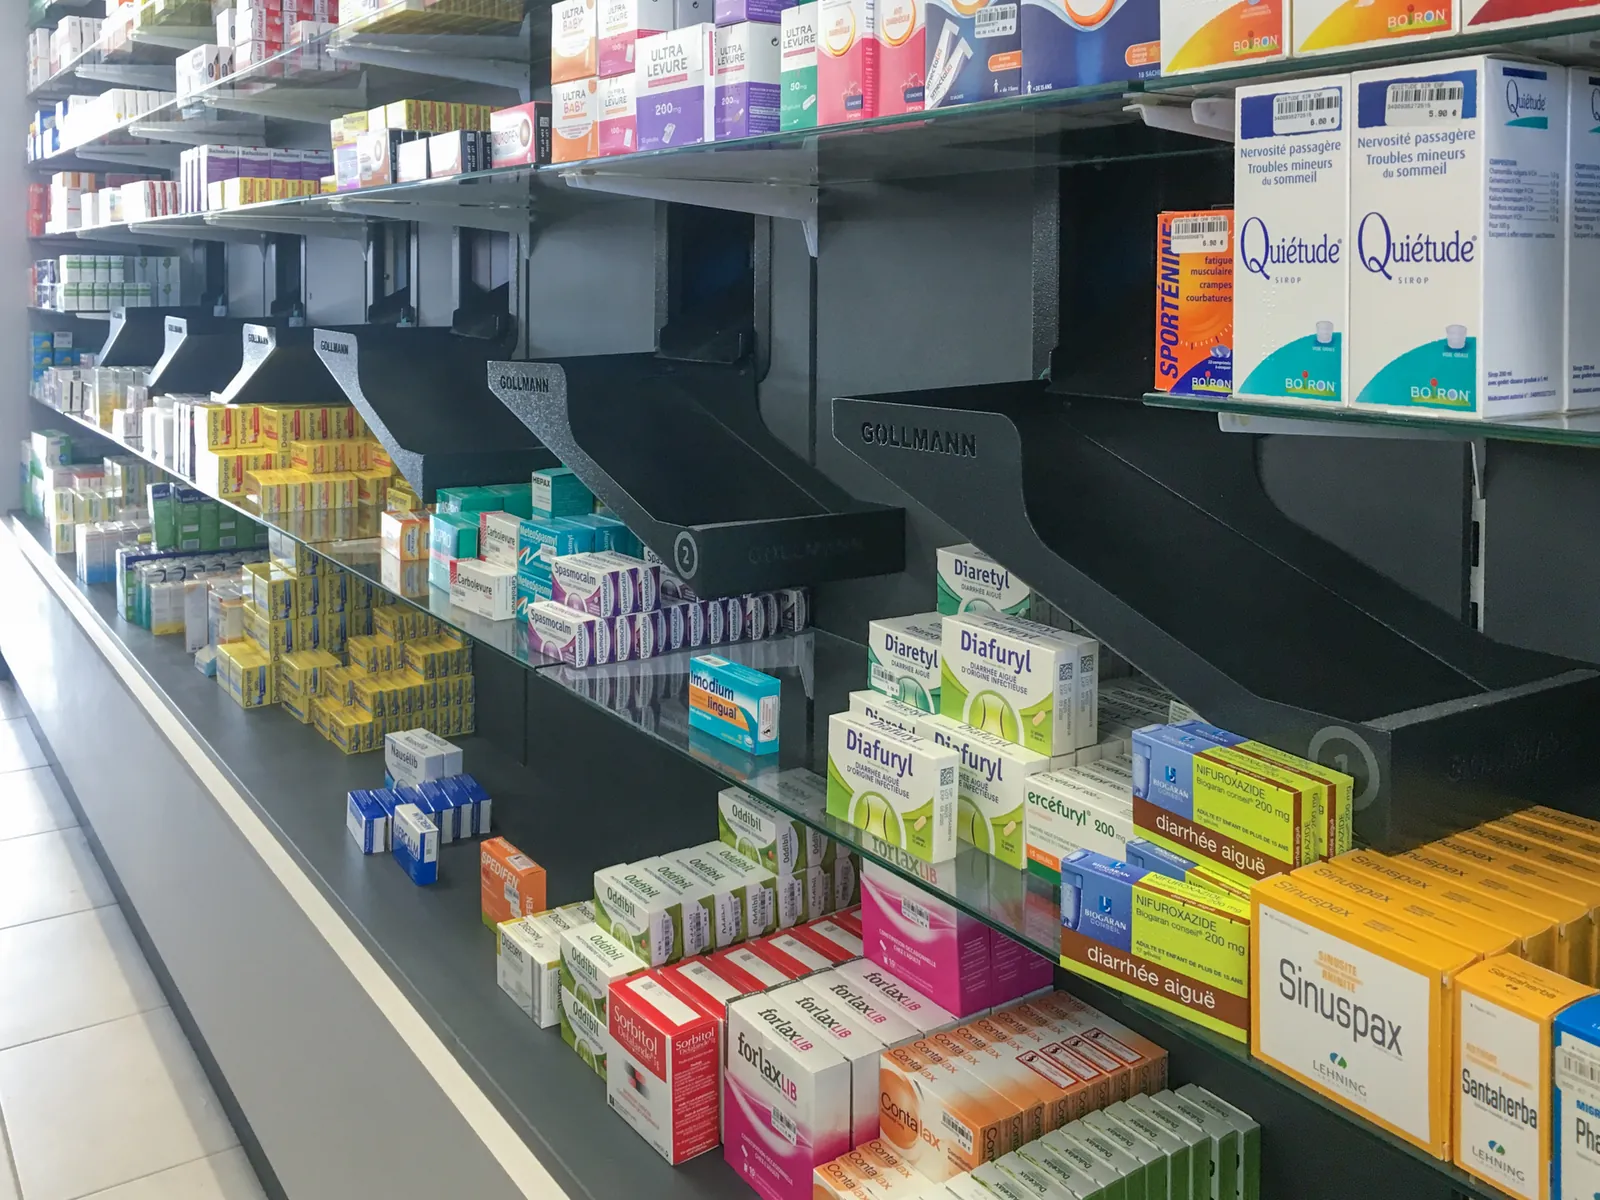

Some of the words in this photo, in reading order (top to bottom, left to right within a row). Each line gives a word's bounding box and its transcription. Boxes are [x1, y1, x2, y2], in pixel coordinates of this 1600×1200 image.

[562, 7, 584, 20] ULTRA
[563, 19, 584, 31] BABY
[1388, 8, 1445, 29] BOIRON
[783, 34, 815, 49] LEVURE
[786, 25, 812, 39] ULTRA
[1233, 35, 1278, 52] BOIRON
[651, 45, 683, 62] ULTRA
[718, 52, 745, 66] LEVURE
[720, 44, 742, 56] ULTRA
[647, 57, 687, 77] LEVURE
[562, 89, 586, 101] ULTRA
[564, 101, 584, 113] BABY
[1506, 79, 1546, 117] Quiétude
[655, 103, 673, 115] 200
[1241, 144, 1286, 158] Nervosité
[1290, 140, 1341, 156] passagère
[1358, 132, 1410, 148] Nervosité
[1415, 129, 1475, 146] passagère
[1248, 161, 1288, 174] Troubles
[1291, 159, 1332, 171] mineurs
[1366, 152, 1413, 165] Troubles
[1417, 149, 1465, 162] mineurs
[1262, 177, 1271, 185] du
[1274, 171, 1317, 185] sommeil
[1383, 169, 1393, 178] du
[1397, 162, 1446, 177] sommeil
[1205, 257, 1232, 266] fatigue
[1200, 282, 1232, 290] crampes
[1275, 276, 1301, 284] SIROP
[1398, 276, 1429, 284] SIROP
[1186, 294, 1232, 302] courbatures
[320, 341, 348, 354] GOLLMANN
[500, 374, 549, 393] GOLLMANN
[1192, 377, 1232, 389] BOIRON
[1285, 378, 1335, 392] BOIRON
[1411, 387, 1469, 401] BOIRON
[861, 421, 977, 458] GOLLMANN
[533, 476, 550, 487] HEPAX
[487, 525, 515, 546] Carbolevure
[682, 546, 689, 564] 2
[457, 573, 492, 596] Carbolevure
[554, 562, 596, 585] Spasmocalm
[954, 558, 1010, 591] Diaretyl
[961, 584, 984, 594] DIARRHÉE
[986, 587, 1001, 600] AIGUË
[531, 609, 571, 635] Spasmocalm
[885, 633, 938, 669] Diaretyl
[961, 630, 1031, 674] Diafuryl
[891, 660, 915, 673] DIARRHÉE
[915, 667, 930, 679] AIGUË
[961, 666, 990, 682] D'ORIGINE
[990, 675, 1028, 695] INFECTIEUSE
[970, 662, 997, 677] DIARRHÉE
[999, 670, 1017, 683] AIGUË
[691, 671, 734, 701] Imodium
[708, 696, 737, 720] lingual
[391, 743, 418, 768] Nausélib
[847, 729, 913, 777] Diafuryl
[847, 766, 874, 782] D'ORIGINE
[874, 775, 910, 799] INFECTIEUSE
[855, 762, 881, 777] DIARRHÉE
[882, 773, 900, 785] AIGUË
[971, 778, 988, 791] AIGUË
[1196, 764, 1265, 799] NIFUROXAZIDE
[963, 781, 1000, 804] INFECTIEUSE
[1153, 779, 1189, 798] BIOGARAN
[1197, 777, 1224, 795] Biogaran
[1256, 799, 1272, 813] 200
[1275, 808, 1290, 823] mg
[732, 805, 762, 832] Oddibil
[1095, 820, 1114, 837] 200
[1116, 834, 1125, 844] mg
[1156, 815, 1217, 853] diarrhée
[1222, 844, 1265, 875] aiguë
[481, 851, 518, 889] SPEDIFEN
[689, 858, 724, 881] Oddibil
[719, 850, 755, 873] Oddibil
[1092, 862, 1130, 877] BIOGARAN
[1351, 856, 1432, 890] Sinuspax
[624, 874, 660, 898] Oddibil
[657, 866, 694, 890] Oddibil
[1313, 867, 1394, 903] Sinuspax
[607, 887, 636, 918] Oddibil
[1273, 880, 1354, 917] Sinuspax
[1084, 909, 1126, 930] BIOGARAN
[1136, 894, 1217, 932] NIFUROXAZIDE
[1090, 919, 1120, 935] CONSEIL
[1136, 909, 1169, 927] Biogaran
[1205, 931, 1225, 947] 200
[1227, 941, 1245, 956] mg
[590, 934, 624, 961] Oddibil
[571, 946, 598, 981] Oddibil
[1136, 940, 1156, 953] ADULTE
[1166, 951, 1187, 964] ENFANT
[1198, 963, 1212, 973] PLUS
[1214, 968, 1222, 976] DE
[1230, 976, 1243, 985] ANS
[1088, 947, 1159, 986] diarrhée
[1164, 978, 1215, 1009] aiguë
[830, 984, 887, 1024] forlaxLIB
[863, 972, 921, 1012] forlaxLIB
[573, 1001, 599, 1036] Oddibil
[796, 997, 852, 1039] forlaxLIB
[1279, 958, 1402, 1056] Sinuspax
[614, 1005, 658, 1056] Sorbitol
[758, 1008, 813, 1051] forlaxLIB
[998, 1012, 1044, 1043] Contalax
[1018, 1005, 1063, 1035] Contalax
[676, 1027, 714, 1051] Sorbitol
[957, 1027, 1002, 1059] Contalax
[977, 1019, 1023, 1051] Contalax
[914, 1041, 957, 1074] Contalax
[935, 1033, 981, 1066] Contalax
[737, 1032, 798, 1101] forlaxLIB
[893, 1049, 939, 1083] Contalax
[1312, 1060, 1367, 1097] LEHNING
[1462, 1068, 1538, 1130] Santaherba
[880, 1092, 941, 1152] Contalax
[849, 1151, 892, 1190] Contalax
[869, 1141, 912, 1178] Contalax
[1472, 1145, 1525, 1182] LEHNING
